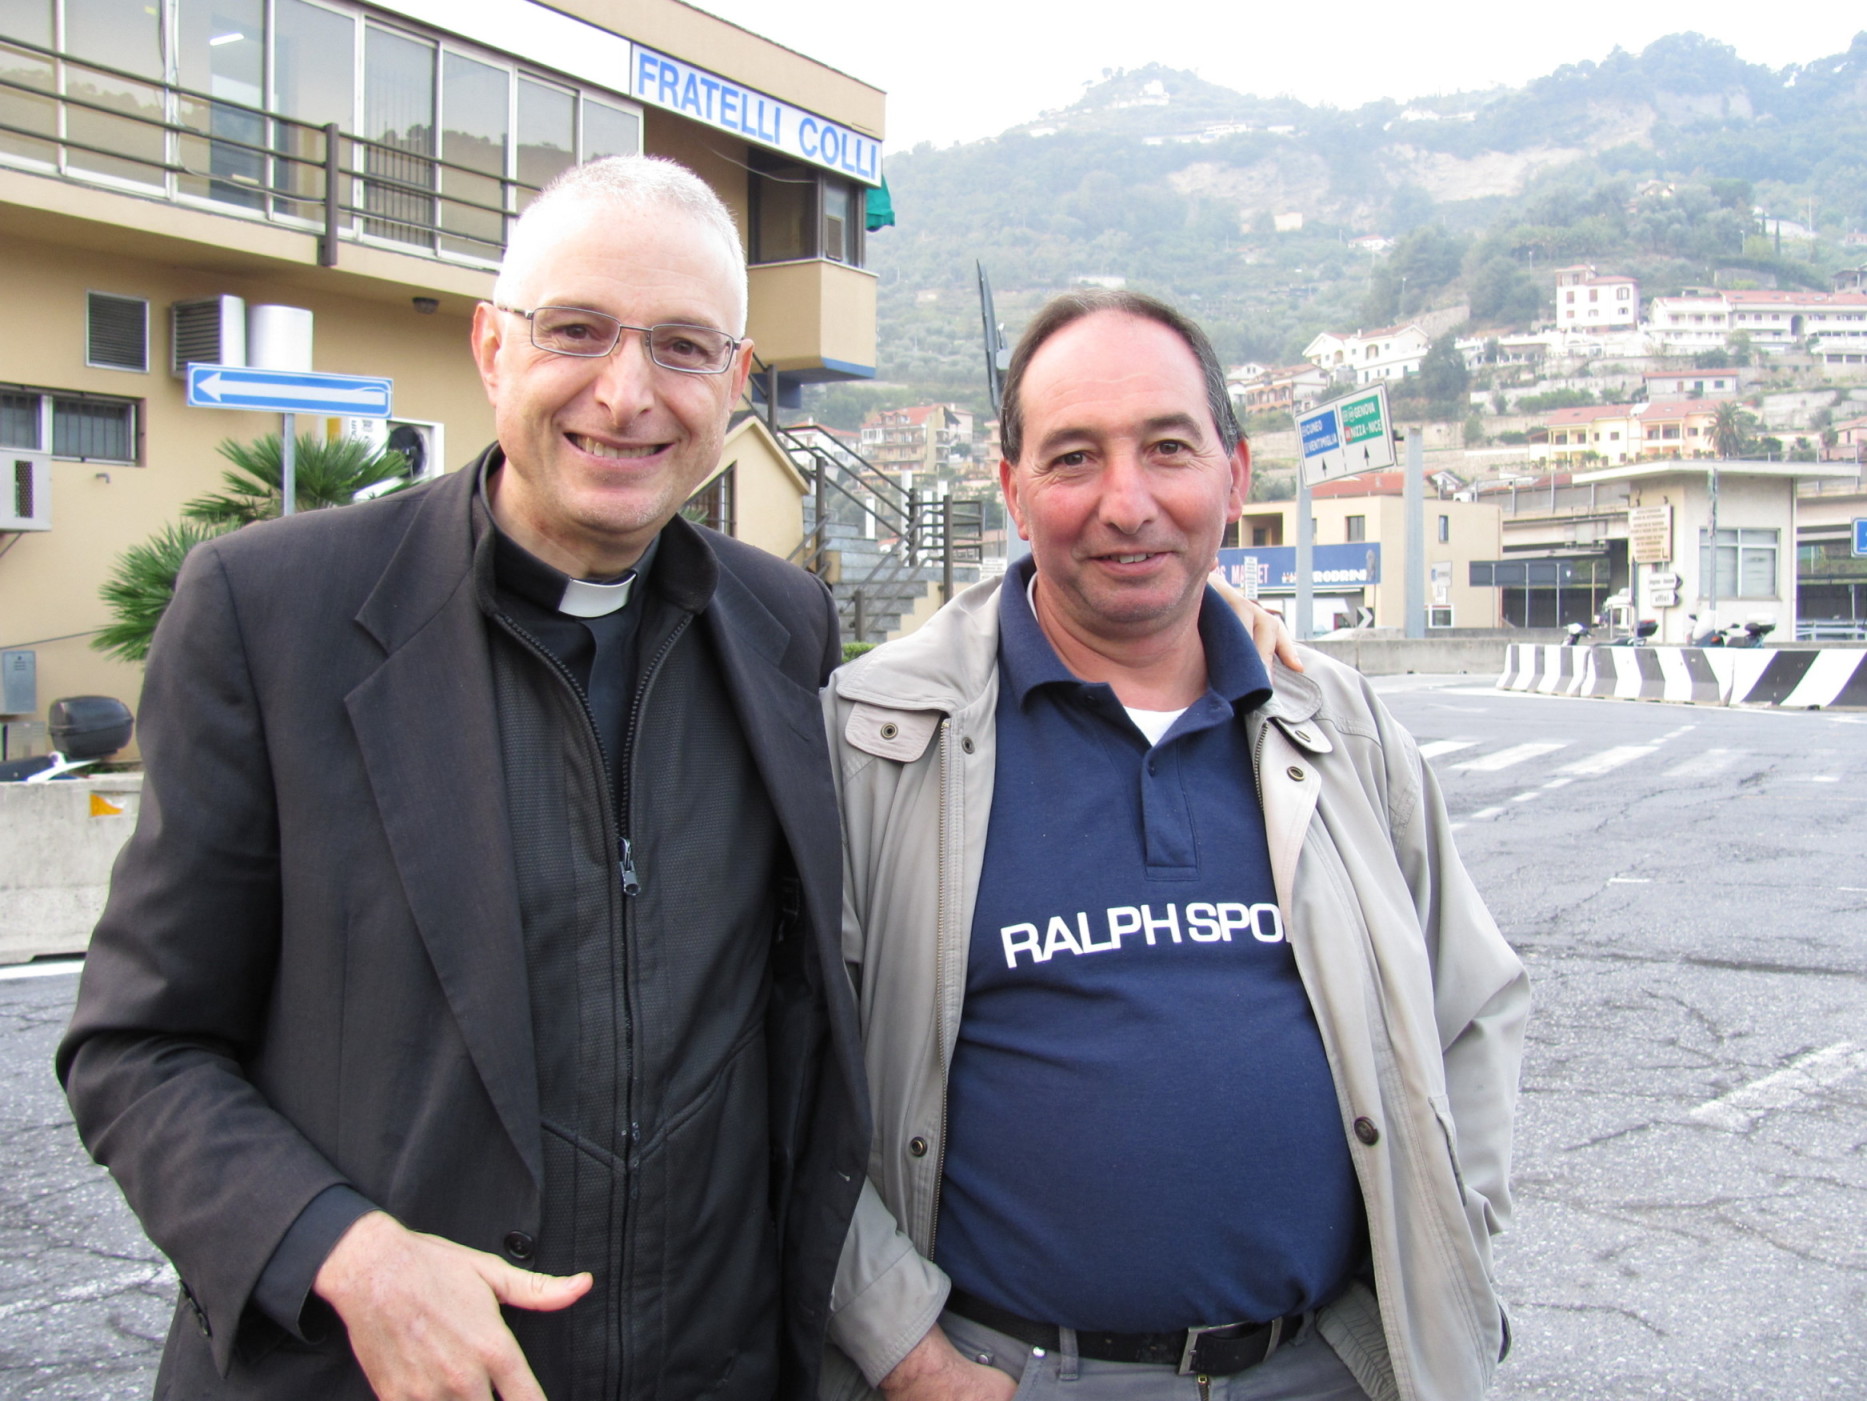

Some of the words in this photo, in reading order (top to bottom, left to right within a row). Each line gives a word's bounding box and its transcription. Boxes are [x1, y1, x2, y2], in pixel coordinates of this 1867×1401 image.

[638, 53, 782, 145] FRATELLI
[799, 117, 877, 180] COLLI
[1231, 564, 1269, 585] MAET
[1000, 903, 1182, 969] RALPH
[1186, 902, 1284, 943] SPO
